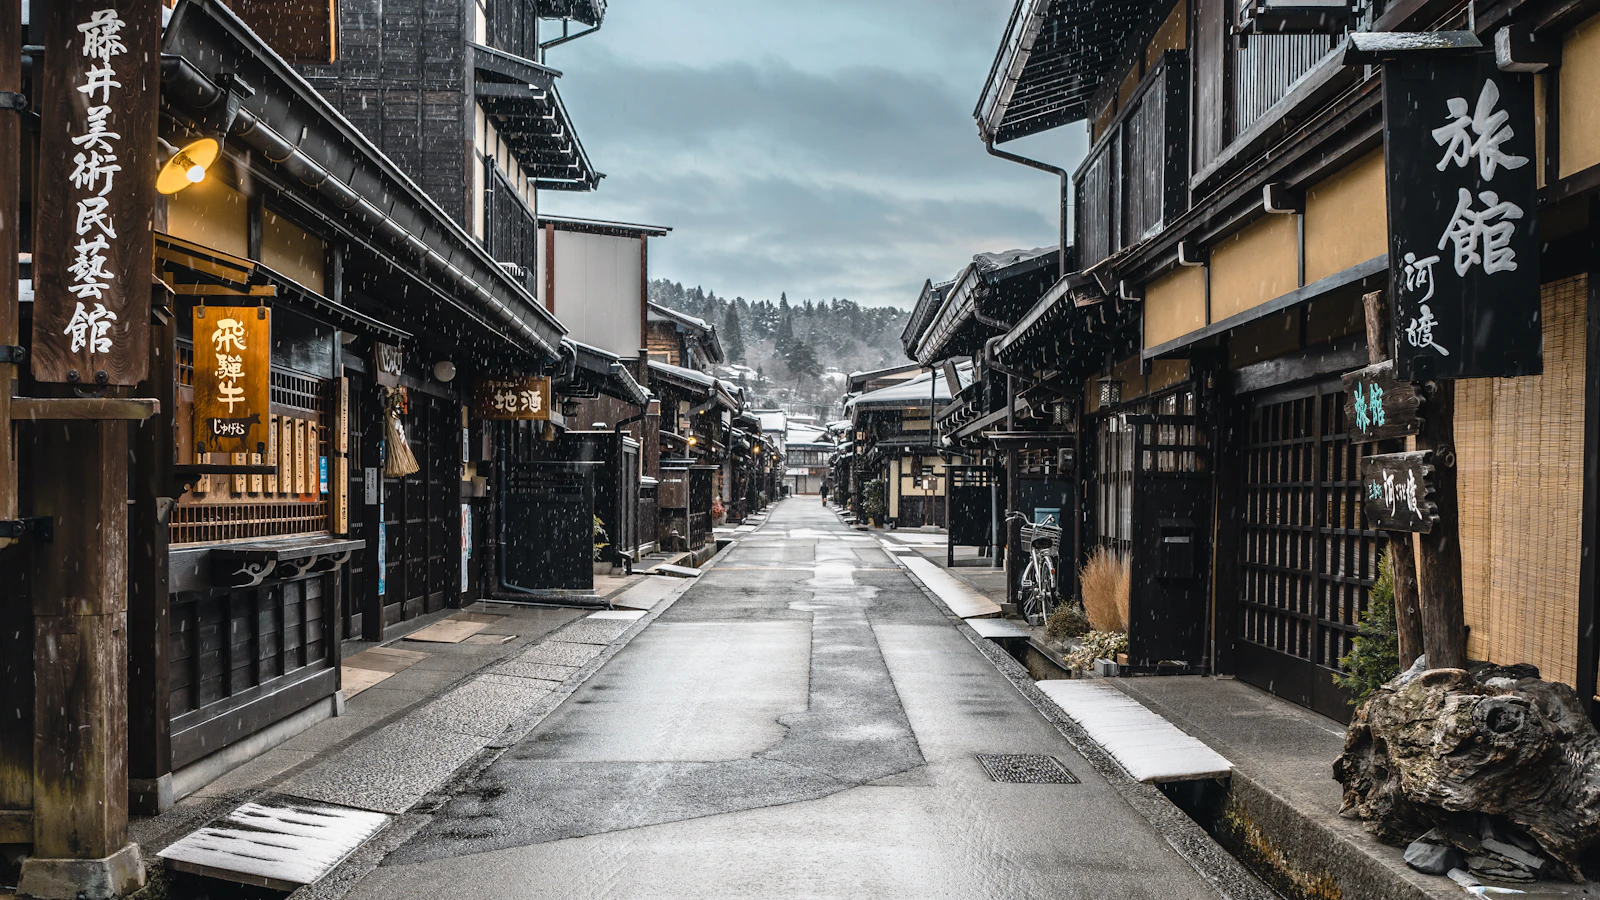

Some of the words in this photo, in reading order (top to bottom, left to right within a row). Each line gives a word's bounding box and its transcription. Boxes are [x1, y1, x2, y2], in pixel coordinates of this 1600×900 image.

[63, 8, 128, 354] 藤井美術民藝館
[1431, 77, 1530, 278] 旅館
[213, 418, 246, 436] じゅげむ
[493, 389, 543, 414] 地酒
